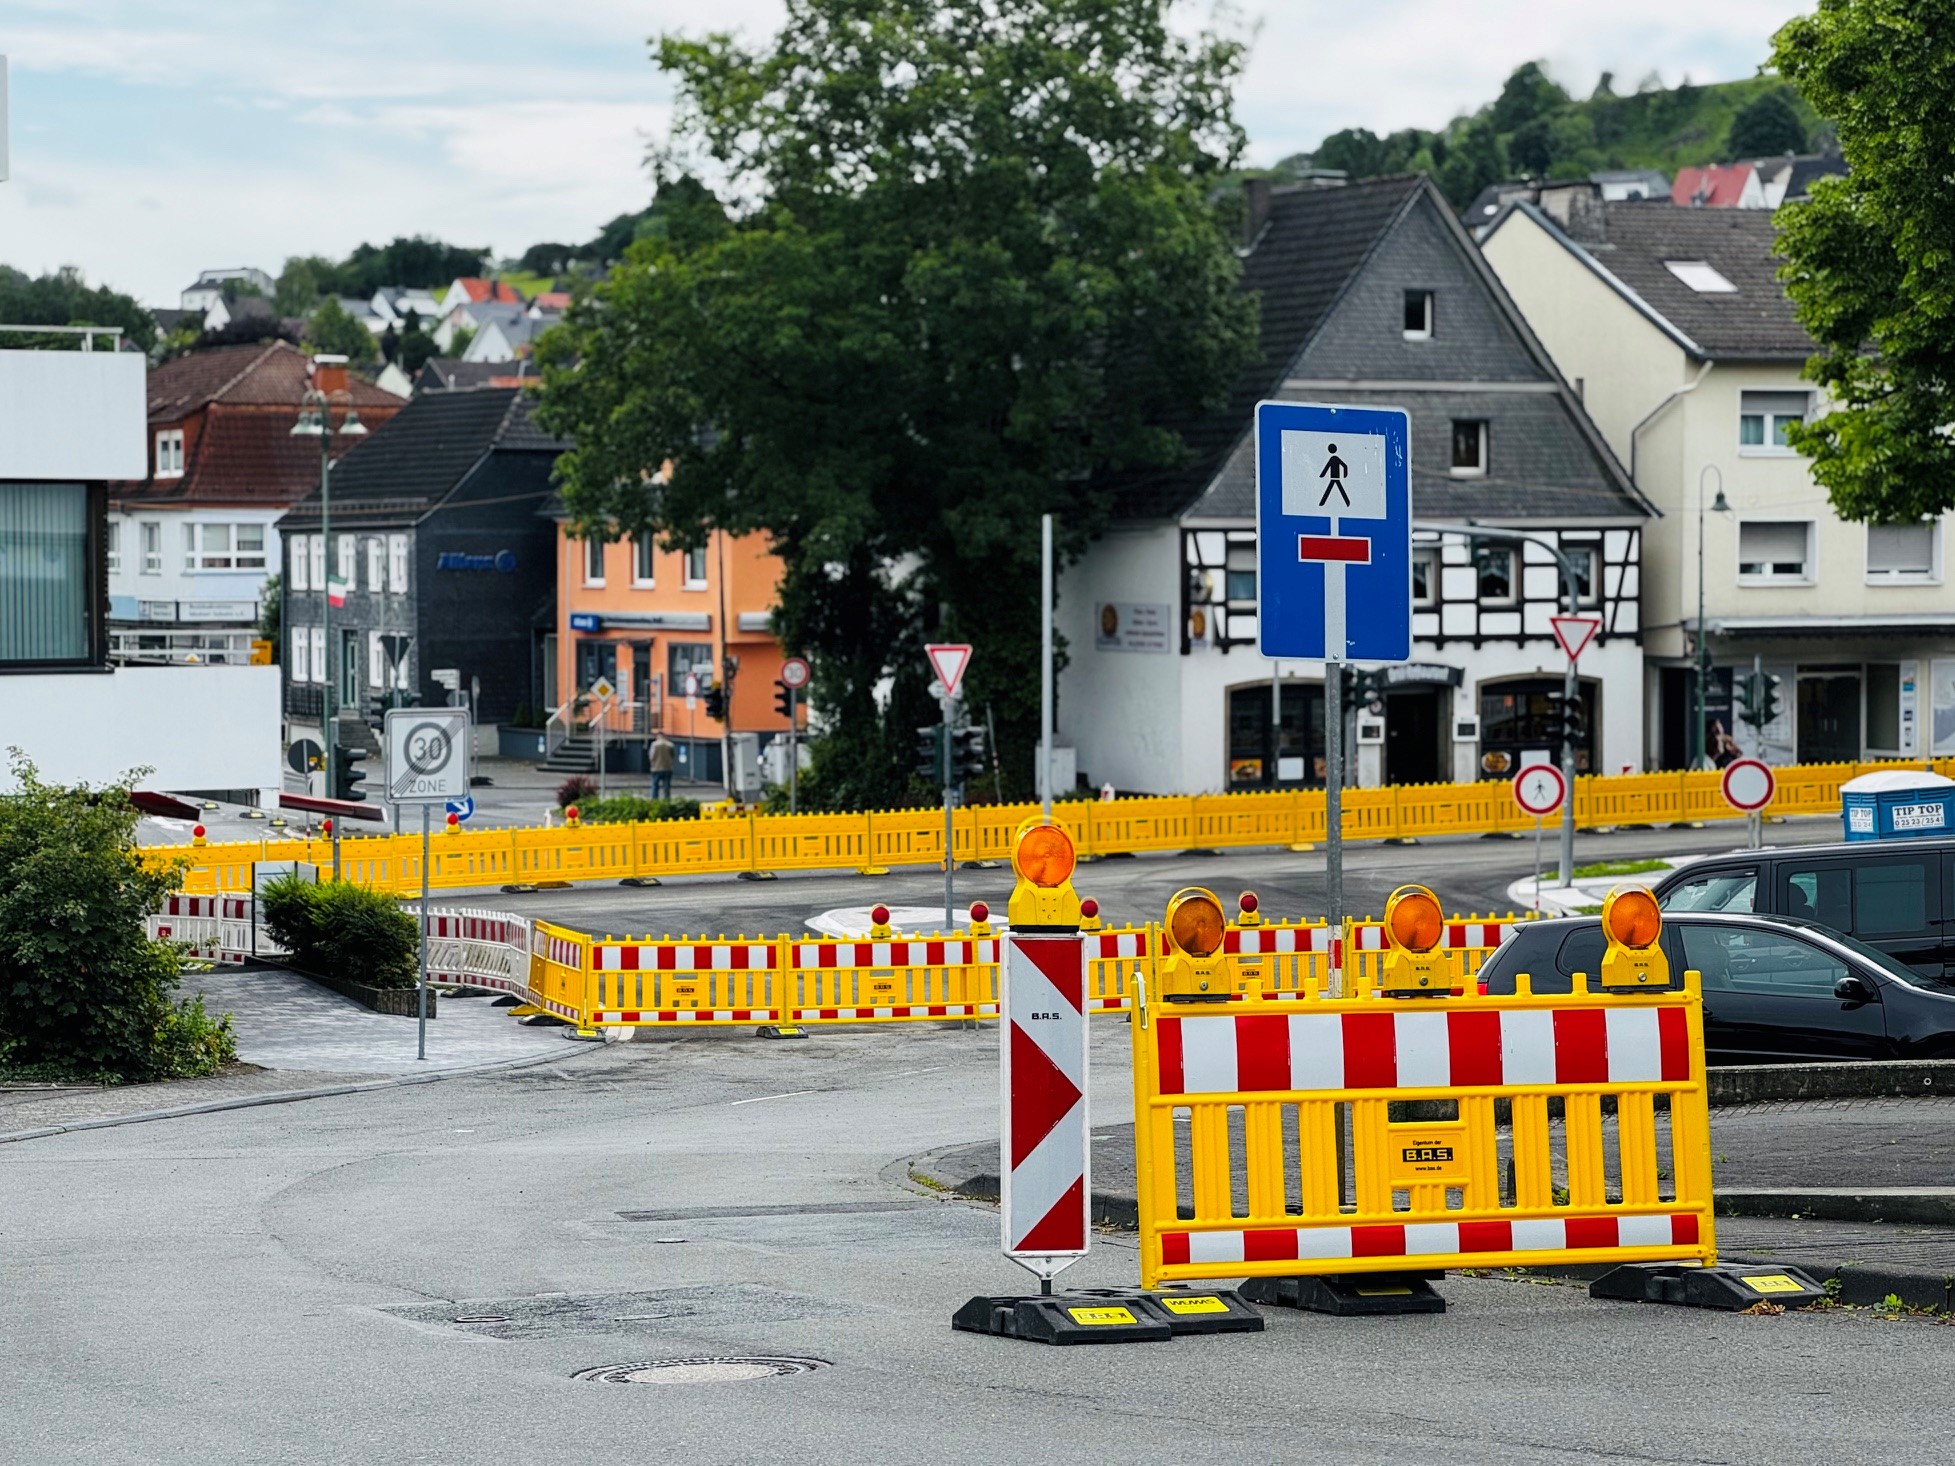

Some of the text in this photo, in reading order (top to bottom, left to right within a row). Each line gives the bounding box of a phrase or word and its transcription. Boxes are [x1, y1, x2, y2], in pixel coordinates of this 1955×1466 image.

[414, 737, 442, 760] 30
[409, 779, 447, 793] ZONE
[1895, 807, 1915, 816] TIP
[1918, 804, 1942, 814] TOP
[1031, 1012, 1062, 1020] B.A.S.
[1405, 1148, 1452, 1161] B.A.S.
